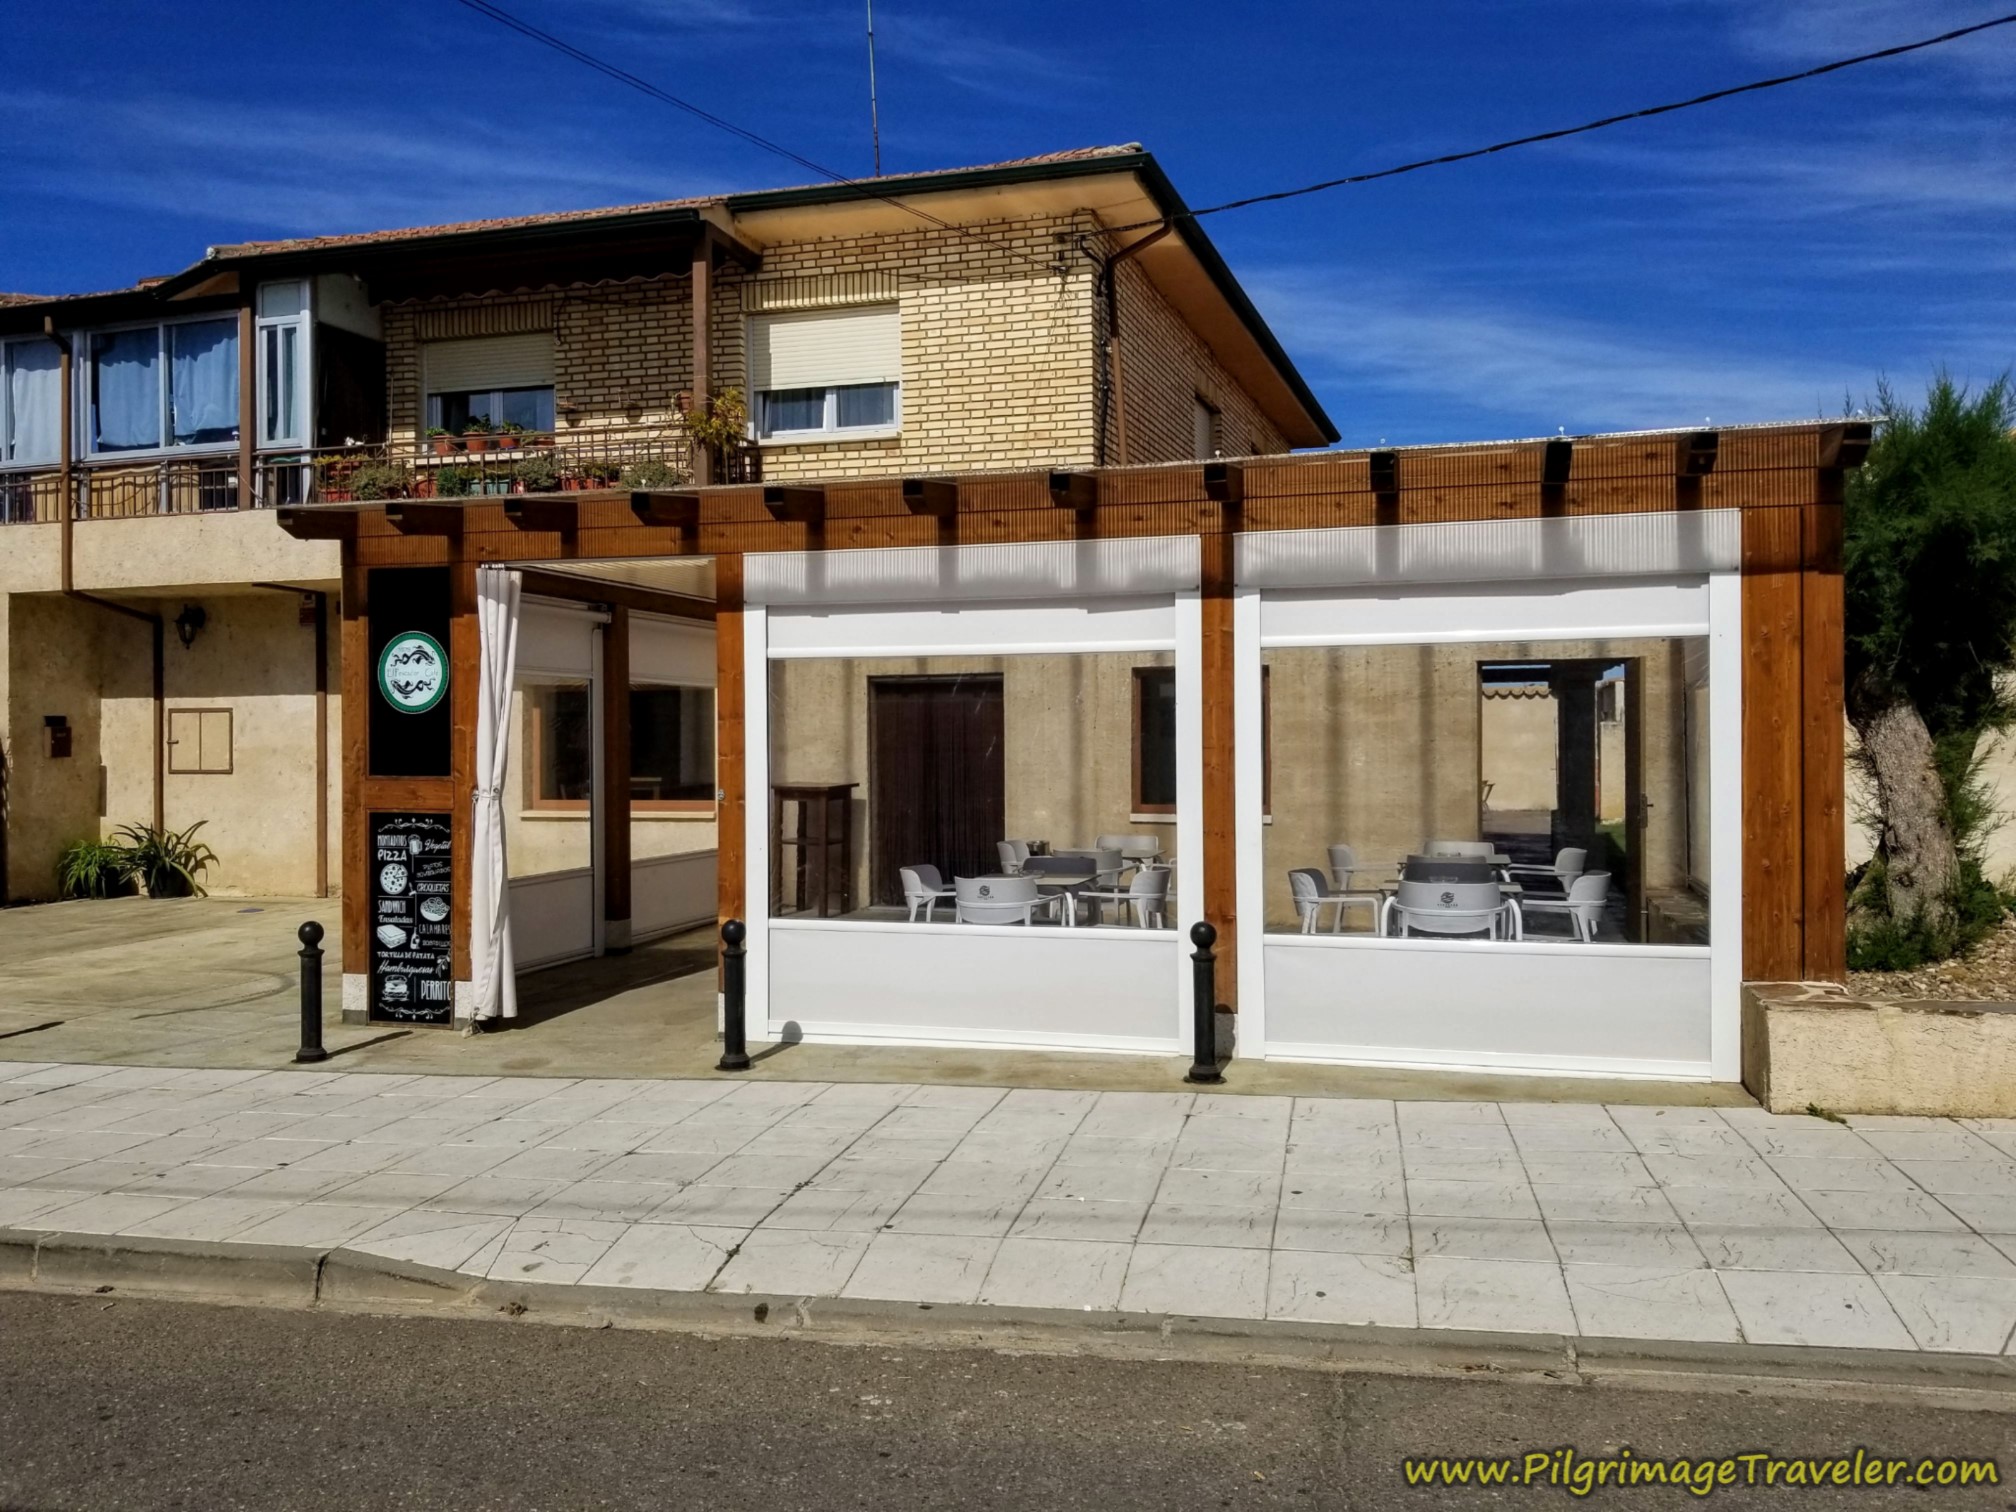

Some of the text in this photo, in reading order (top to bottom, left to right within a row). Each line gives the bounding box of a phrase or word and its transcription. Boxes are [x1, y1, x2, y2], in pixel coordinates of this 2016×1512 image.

[424, 838, 452, 854] Vegetal
[377, 849, 407, 861] PIZZA
[416, 883, 450, 893] CROQUETAS
[377, 899, 406, 914] SANDWICH
